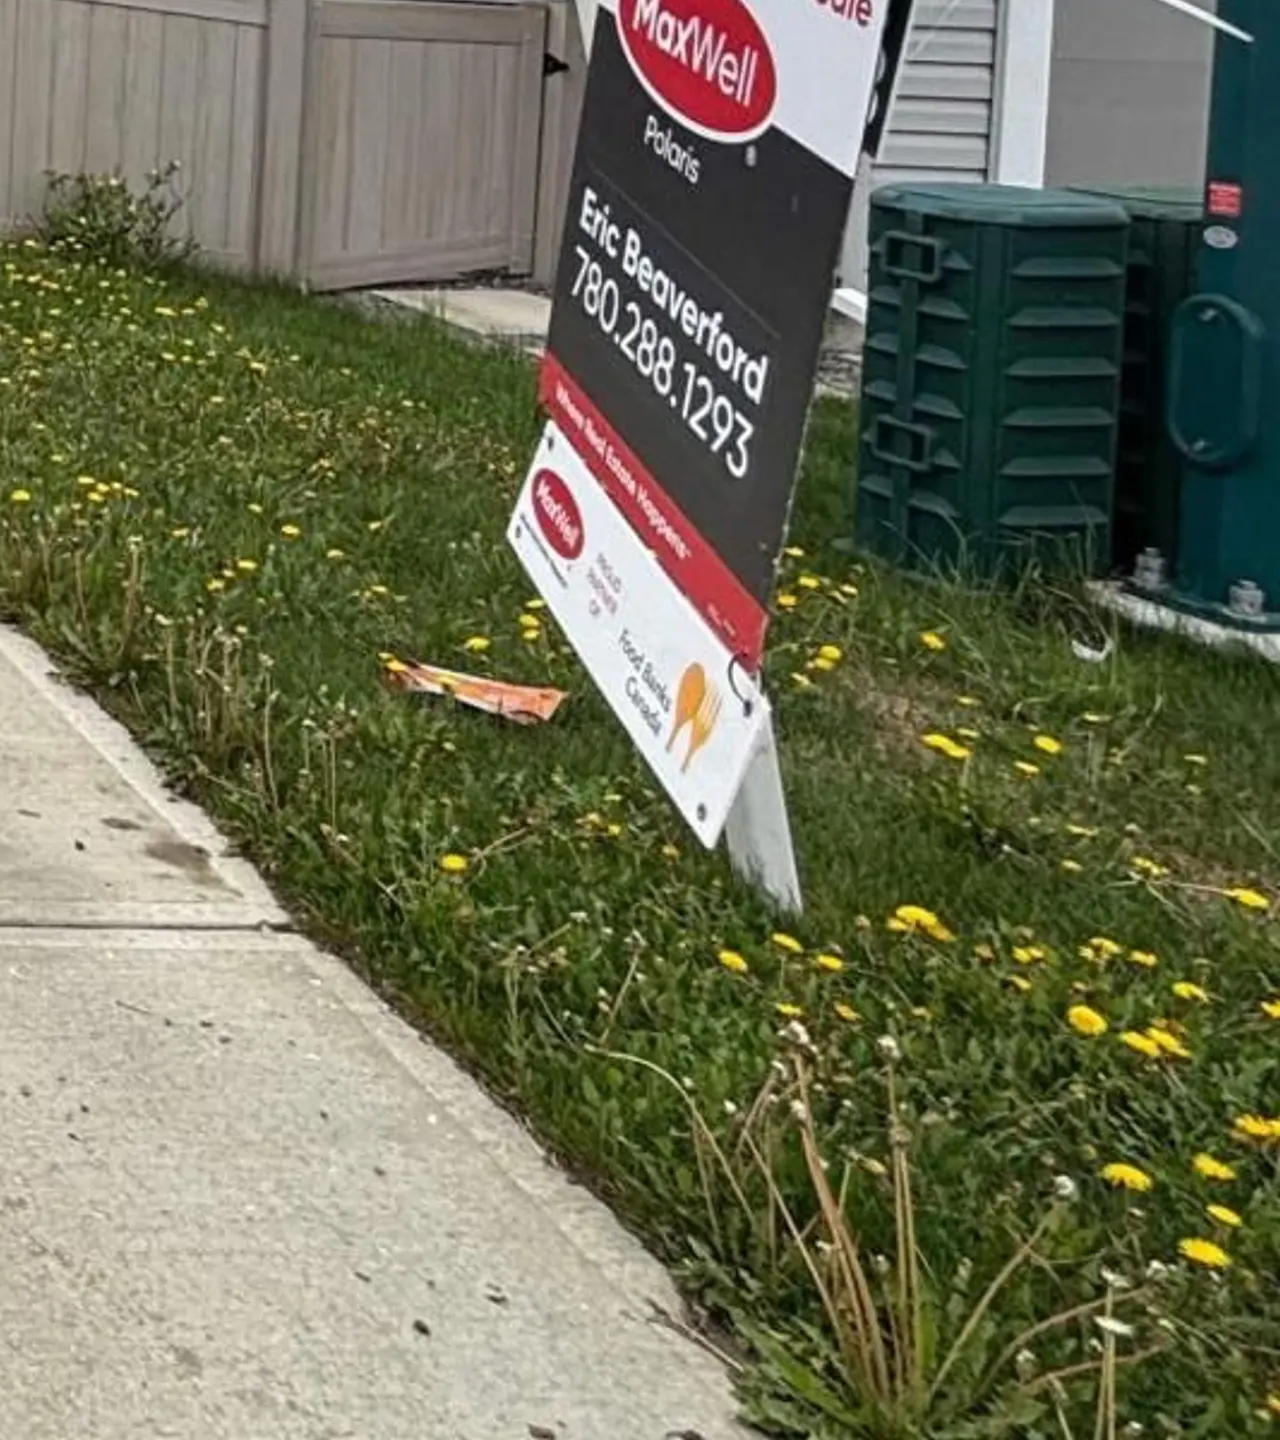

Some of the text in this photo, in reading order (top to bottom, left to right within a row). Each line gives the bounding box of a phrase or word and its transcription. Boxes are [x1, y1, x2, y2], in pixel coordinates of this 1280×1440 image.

[643, 114, 701, 184] Polaris
[571, 245, 755, 479] 780.288.1293
[579, 186, 769, 405] Eric Beaverford
[625, 676, 662, 738] Canada
